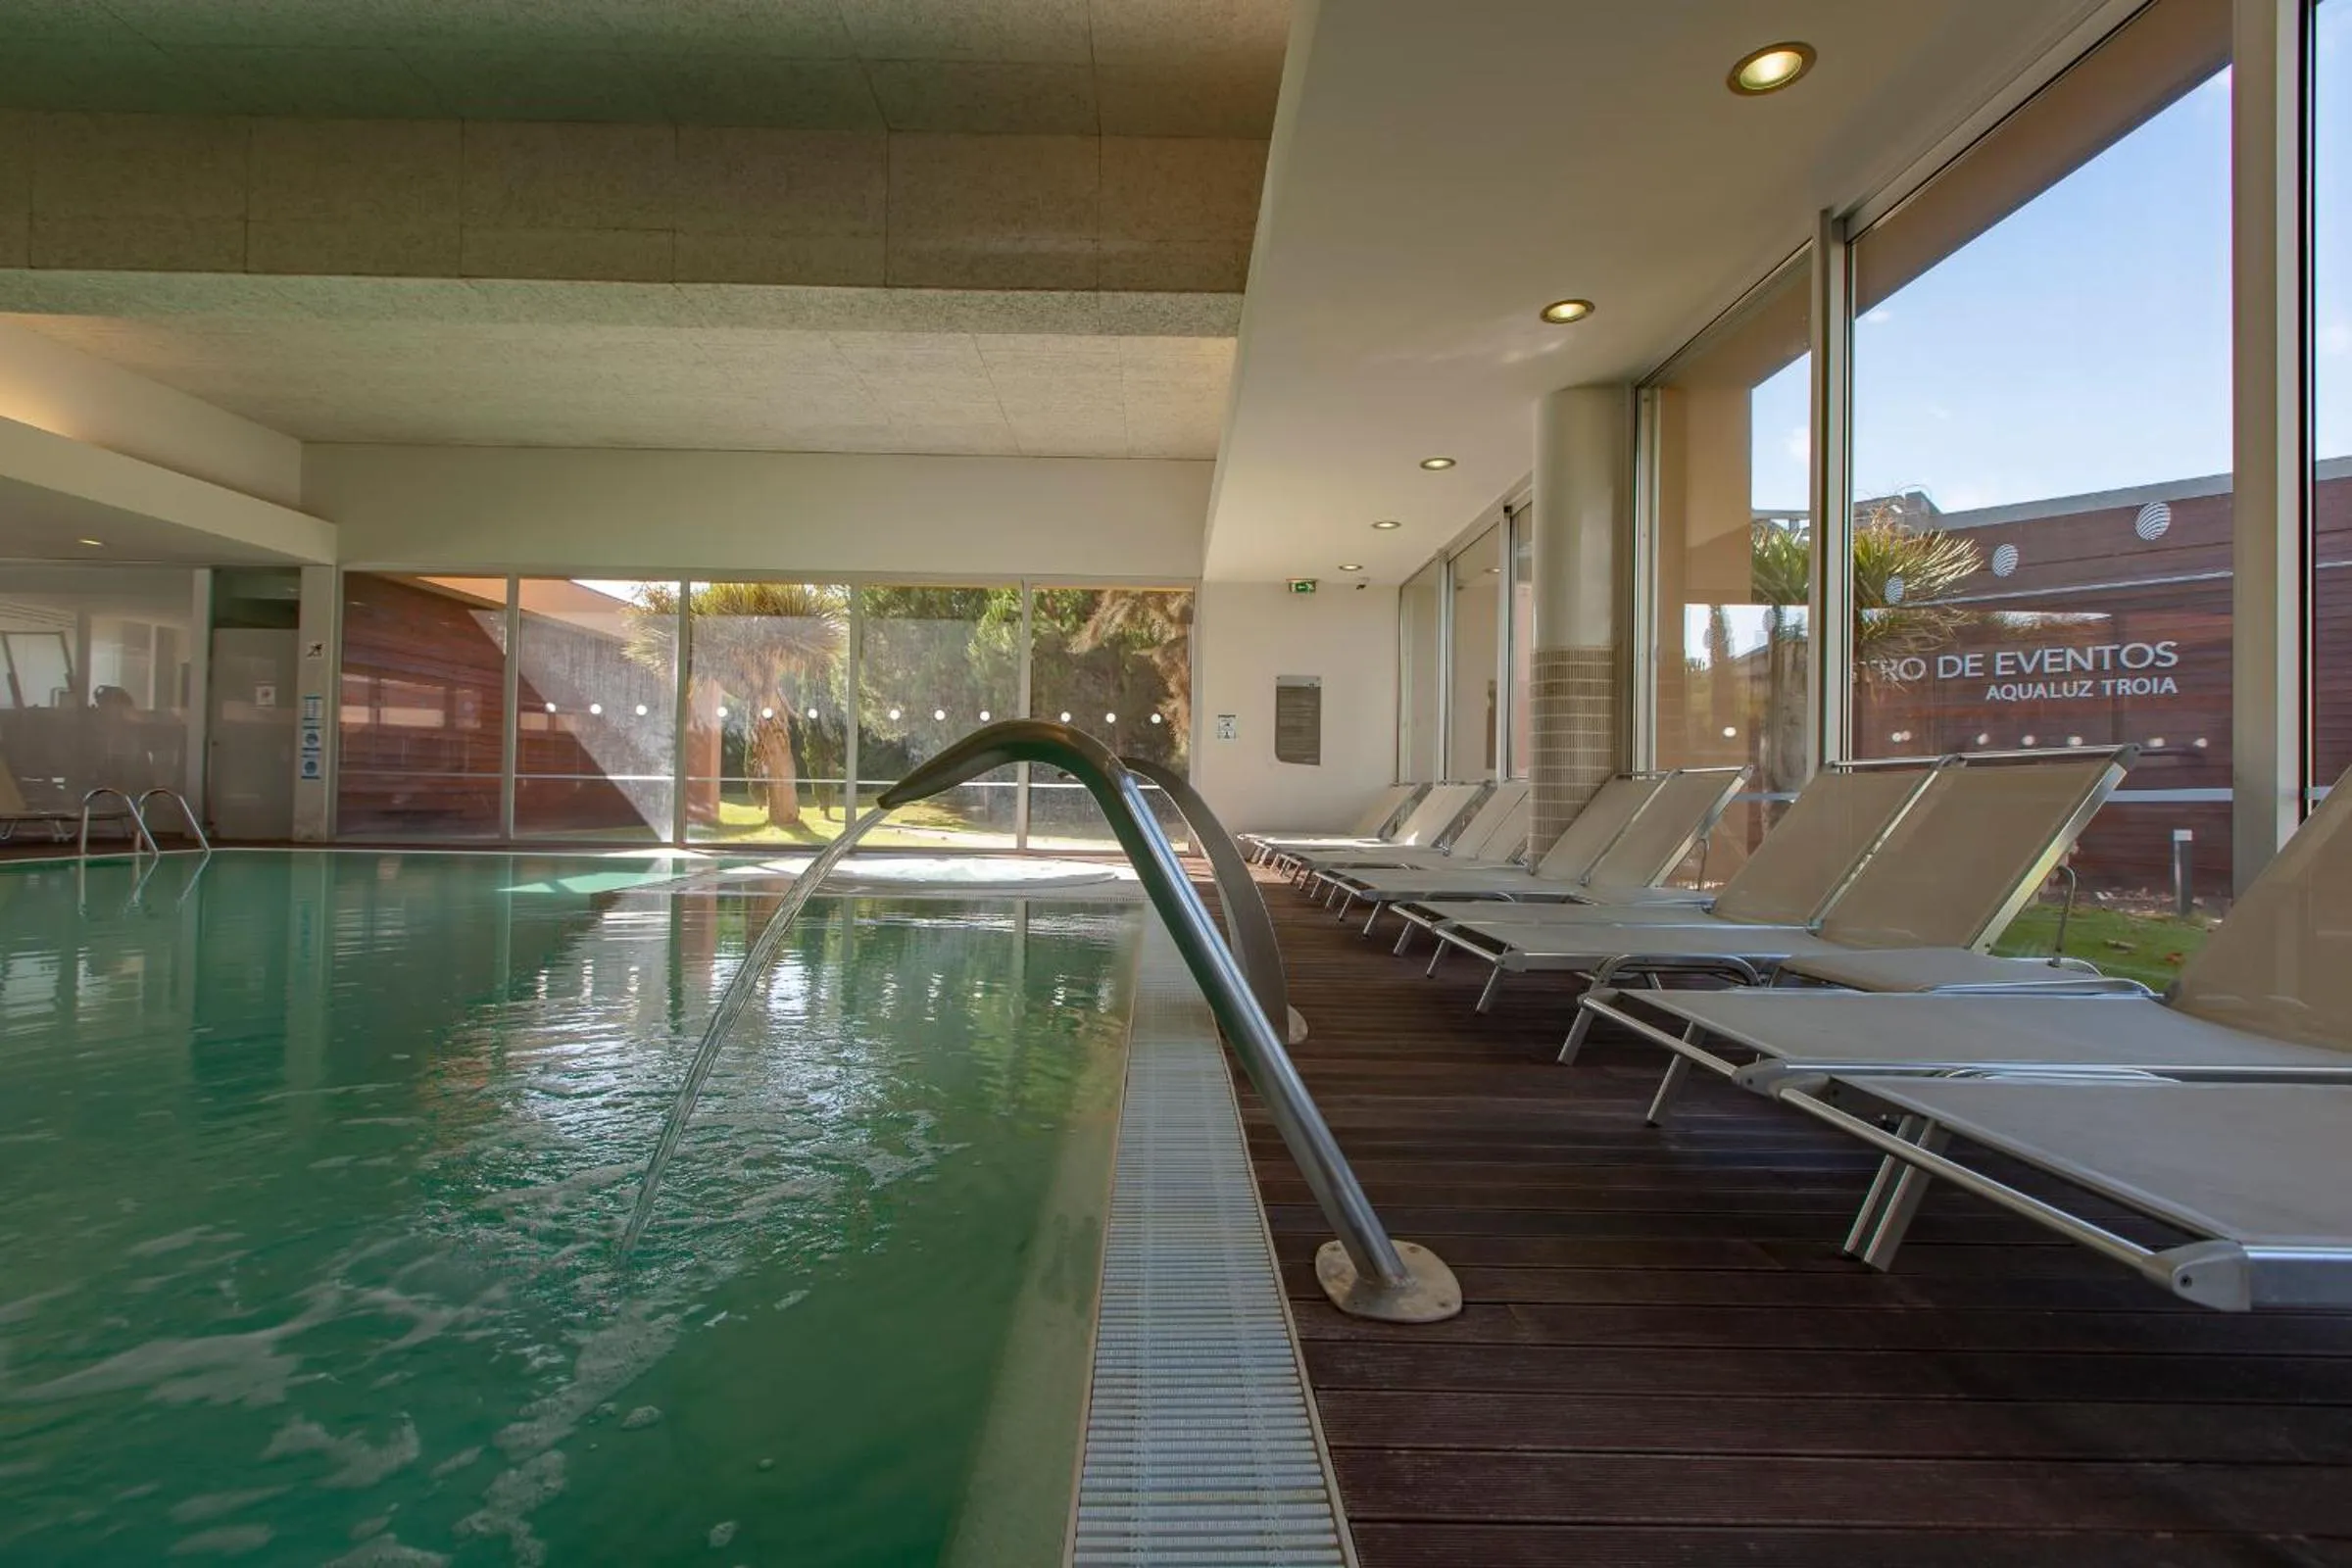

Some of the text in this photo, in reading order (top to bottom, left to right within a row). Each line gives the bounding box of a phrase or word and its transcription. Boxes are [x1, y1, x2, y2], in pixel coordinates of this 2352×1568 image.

[1937, 654, 1984, 678] DE
[1995, 641, 2179, 675] EVENTOS
[1986, 677, 2178, 701] AQUALUZ TROIA
